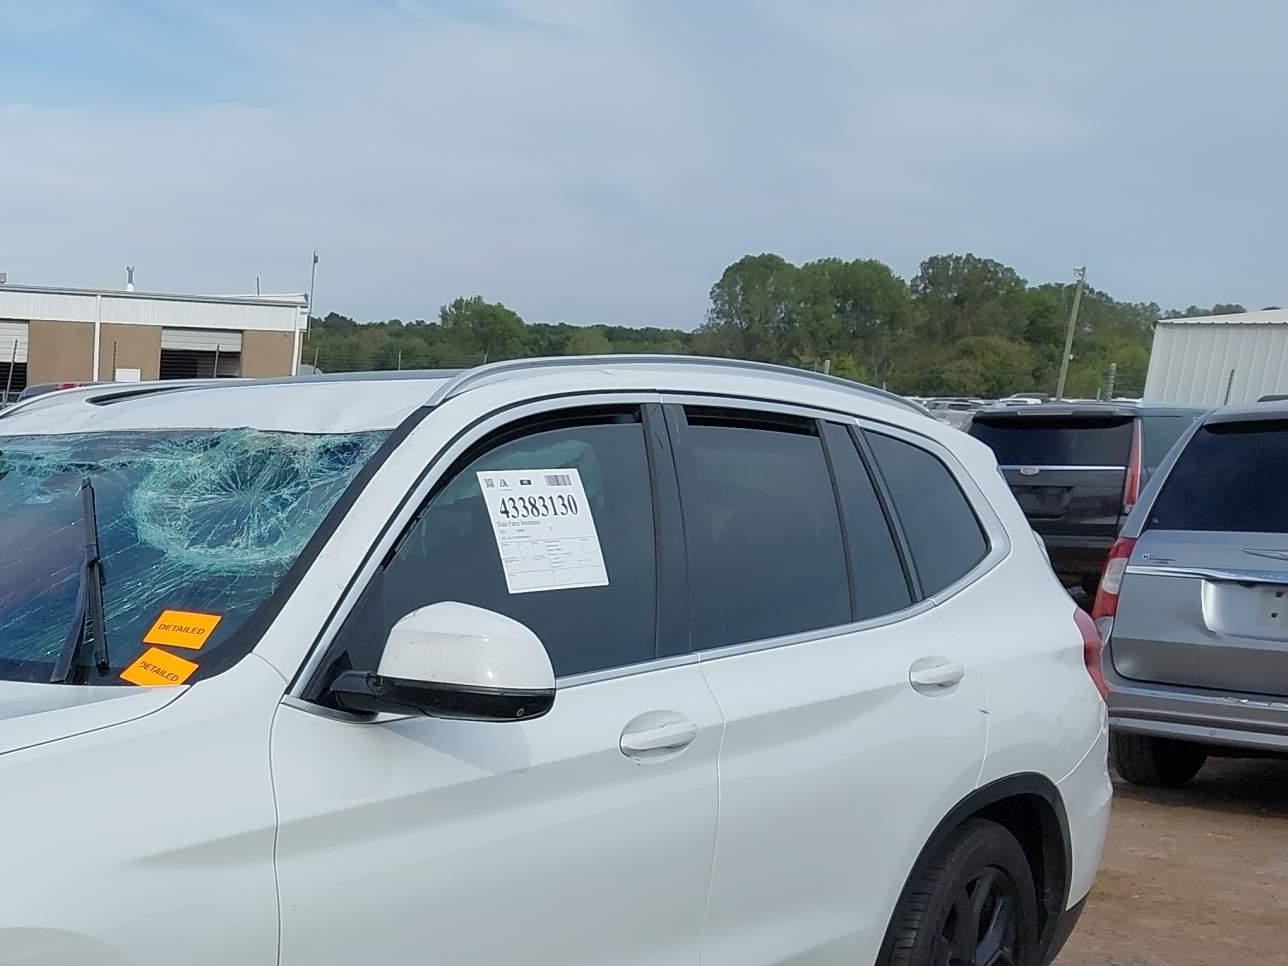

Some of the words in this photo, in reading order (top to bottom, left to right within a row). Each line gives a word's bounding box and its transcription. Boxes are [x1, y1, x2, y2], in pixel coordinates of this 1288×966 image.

[499, 494, 578, 519] 43383130
[158, 623, 206, 635] DETAILED
[139, 660, 180, 682] DETAILED
